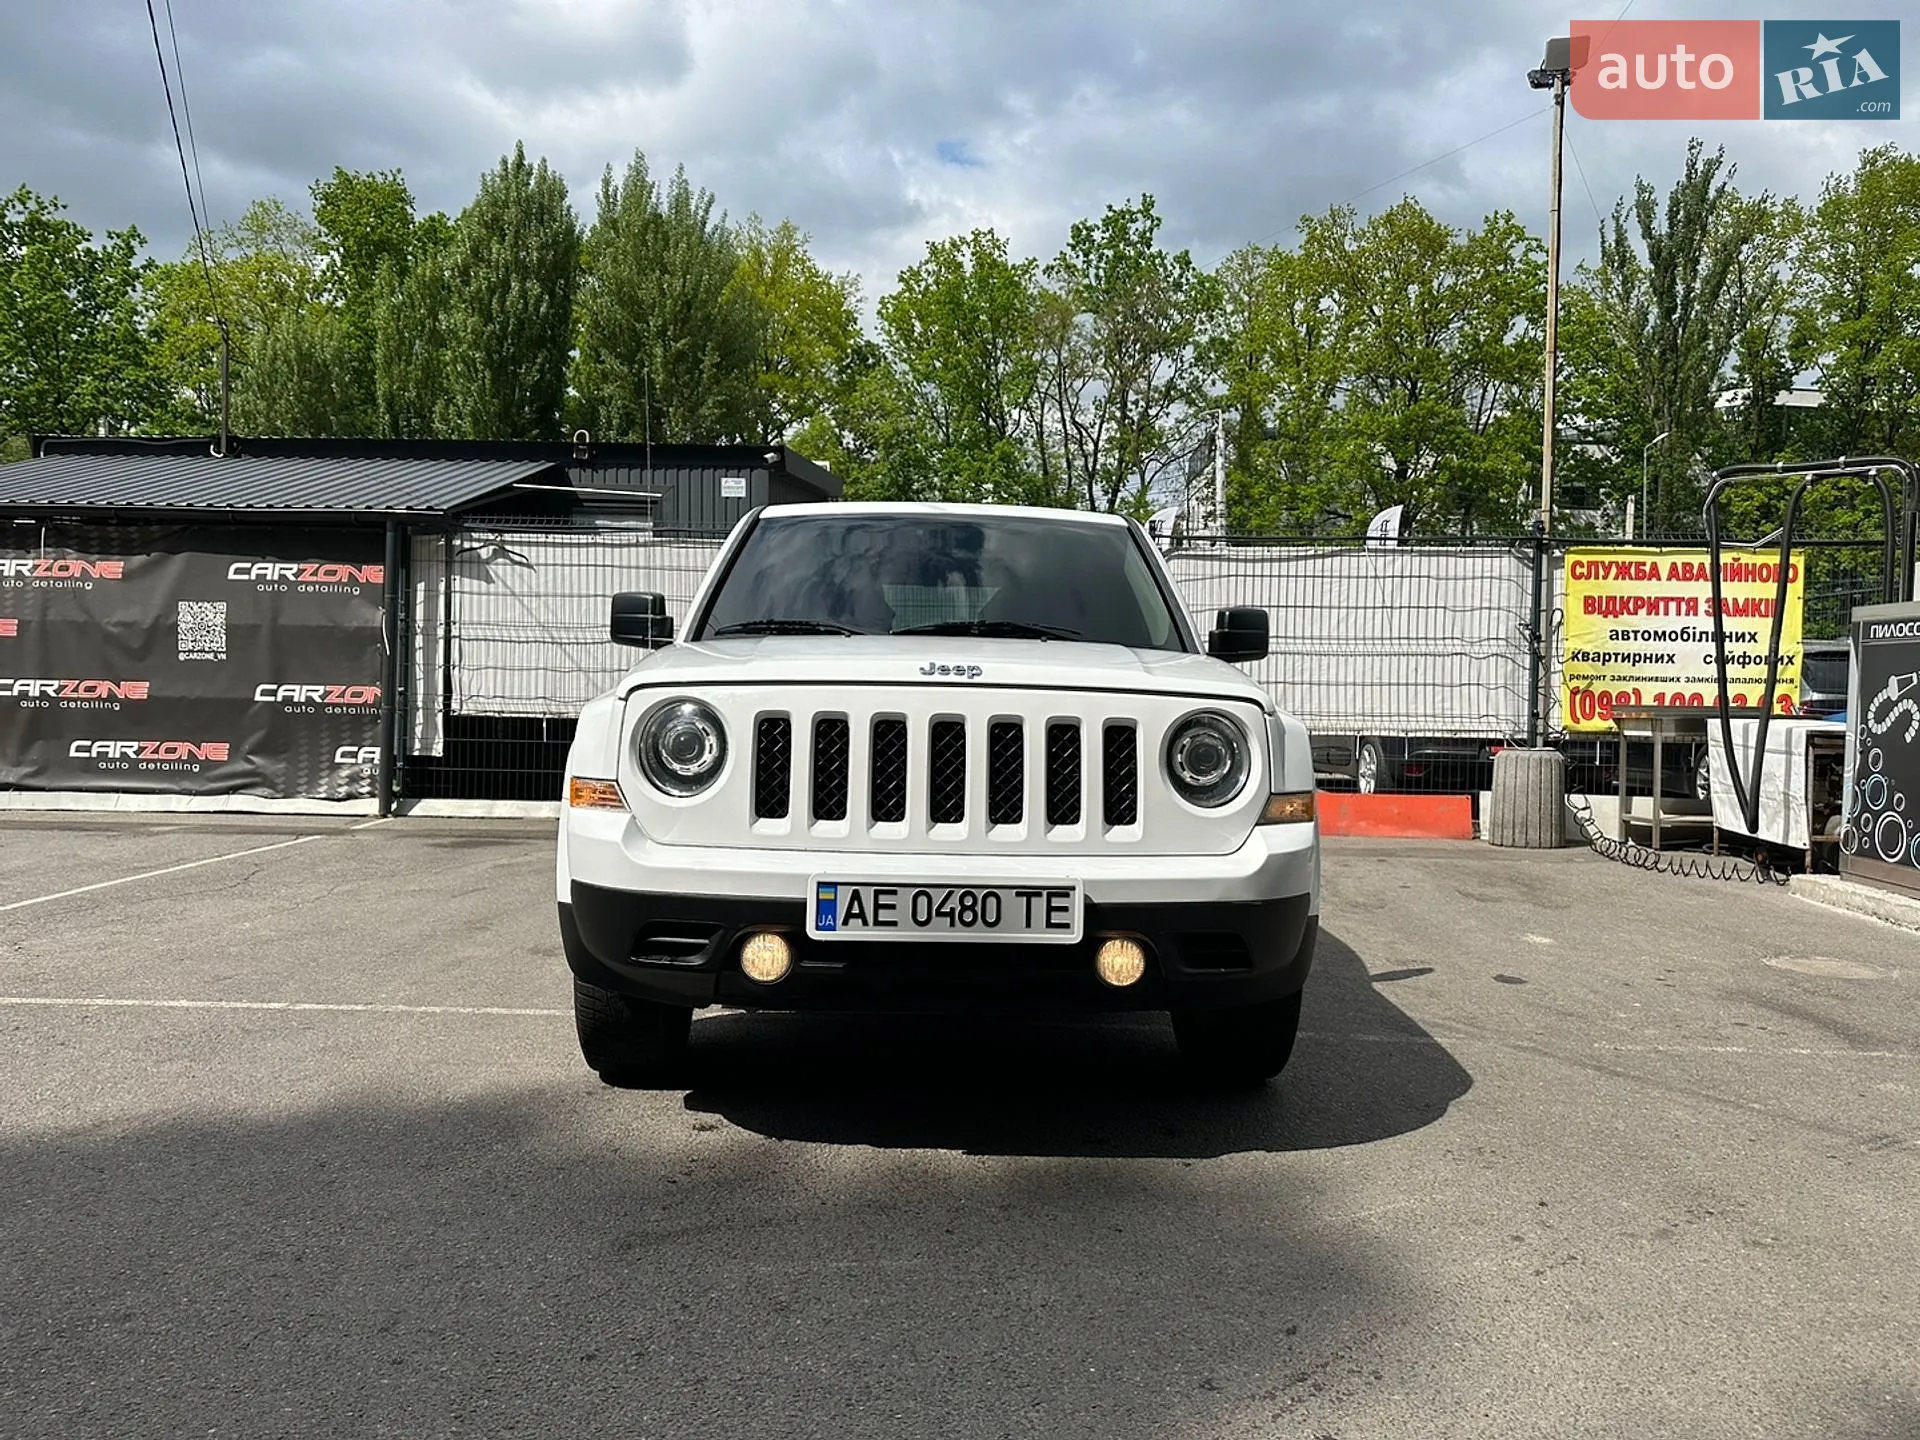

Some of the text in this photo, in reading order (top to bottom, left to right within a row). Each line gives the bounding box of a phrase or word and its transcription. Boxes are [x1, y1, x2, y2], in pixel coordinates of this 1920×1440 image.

[228, 562, 384, 584] CARZONE
[1570, 557, 1799, 584] СЛУЖБА АВАІЙНОО
[32, 579, 93, 590] detailing
[257, 583, 360, 595] auto detailing
[1583, 595, 1699, 618] ВІДКРИТТЯ
[1570, 649, 1795, 669] квартирних сйфоих
[919, 662, 983, 679] Jeep
[1569, 673, 1607, 682] ремонт
[0, 679, 150, 699] CARZONE
[20, 699, 120, 711] auto detailing
[284, 704, 382, 716] auto detailin
[69, 740, 230, 761] CARZONE
[98, 761, 200, 772] auto detailing
[841, 888, 1071, 929] AE 0480 TE
[818, 914, 835, 926] UA
